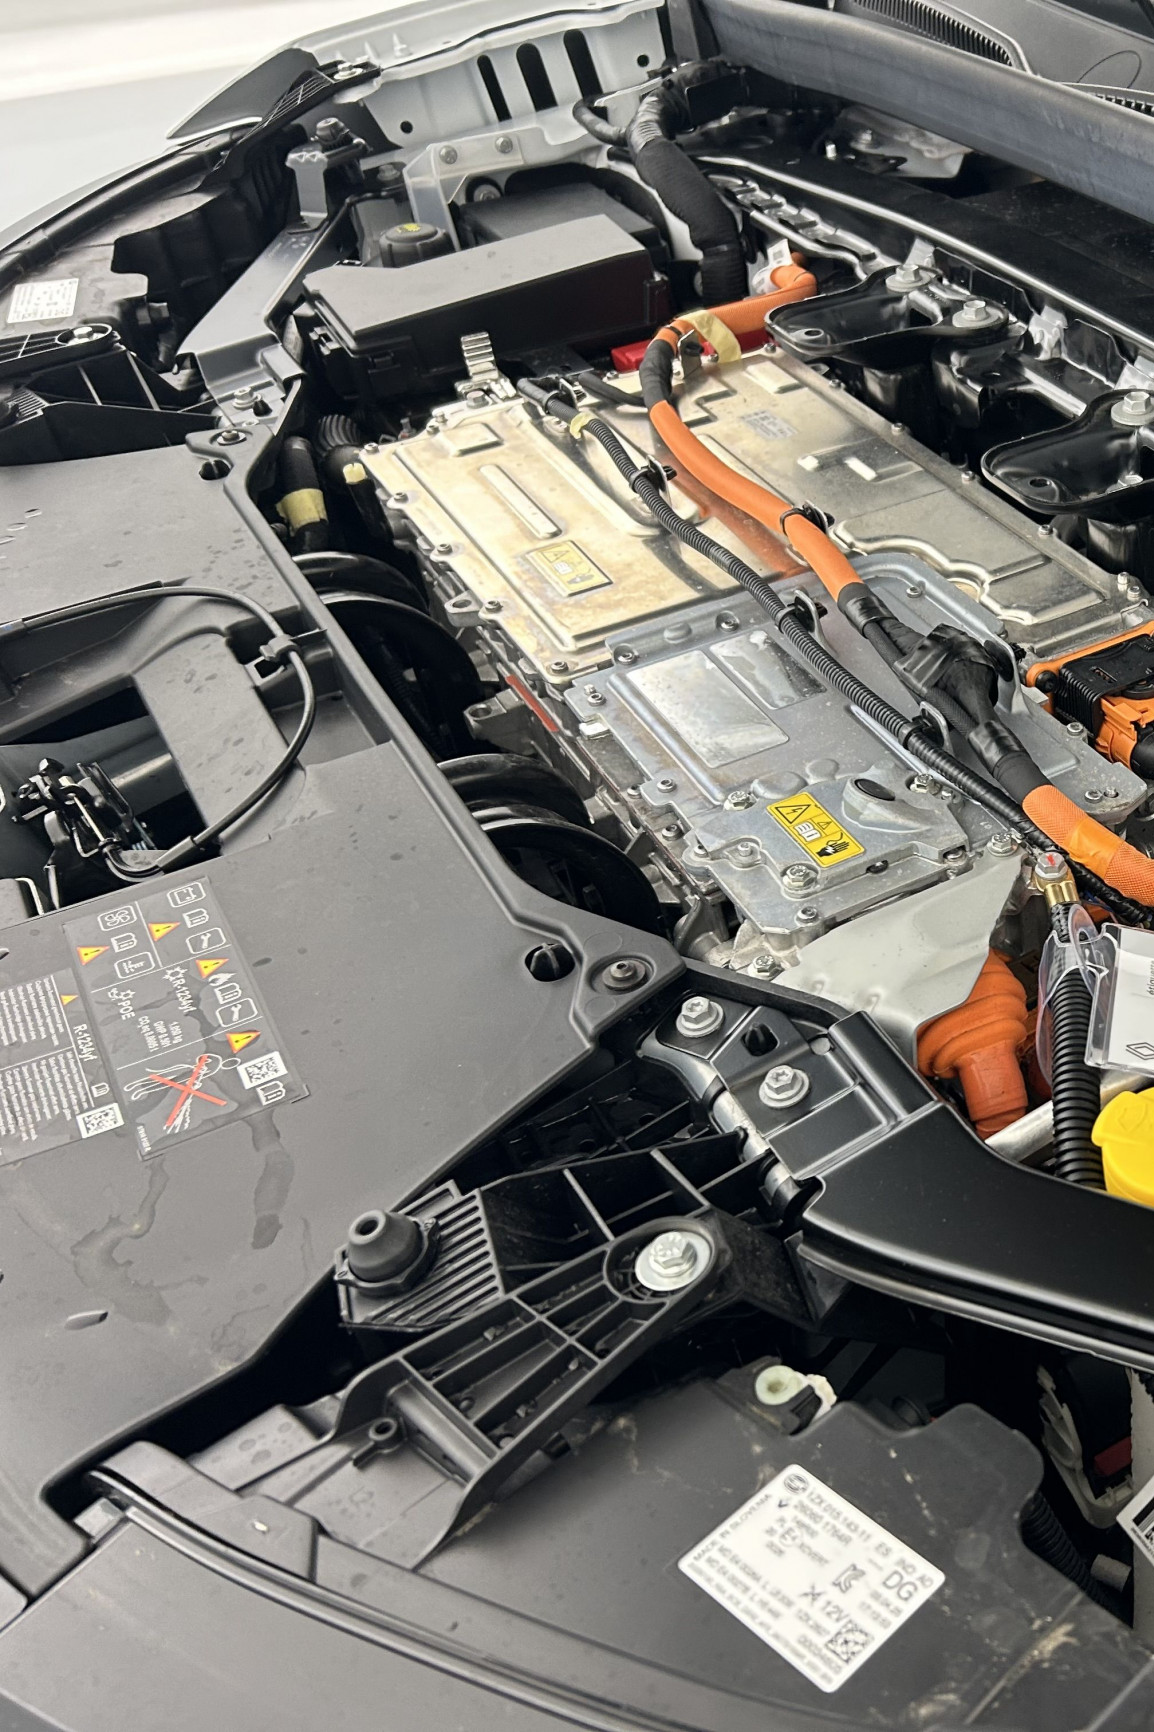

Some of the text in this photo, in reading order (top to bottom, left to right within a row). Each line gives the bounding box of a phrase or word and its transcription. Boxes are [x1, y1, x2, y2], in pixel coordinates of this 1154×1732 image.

[117, 999, 135, 1020] POE
[168, 977, 197, 1015] R-1234yf
[69, 1023, 97, 1063] R-1234yf
[880, 1569, 920, 1602] DG
[818, 1598, 850, 1625] 12V
